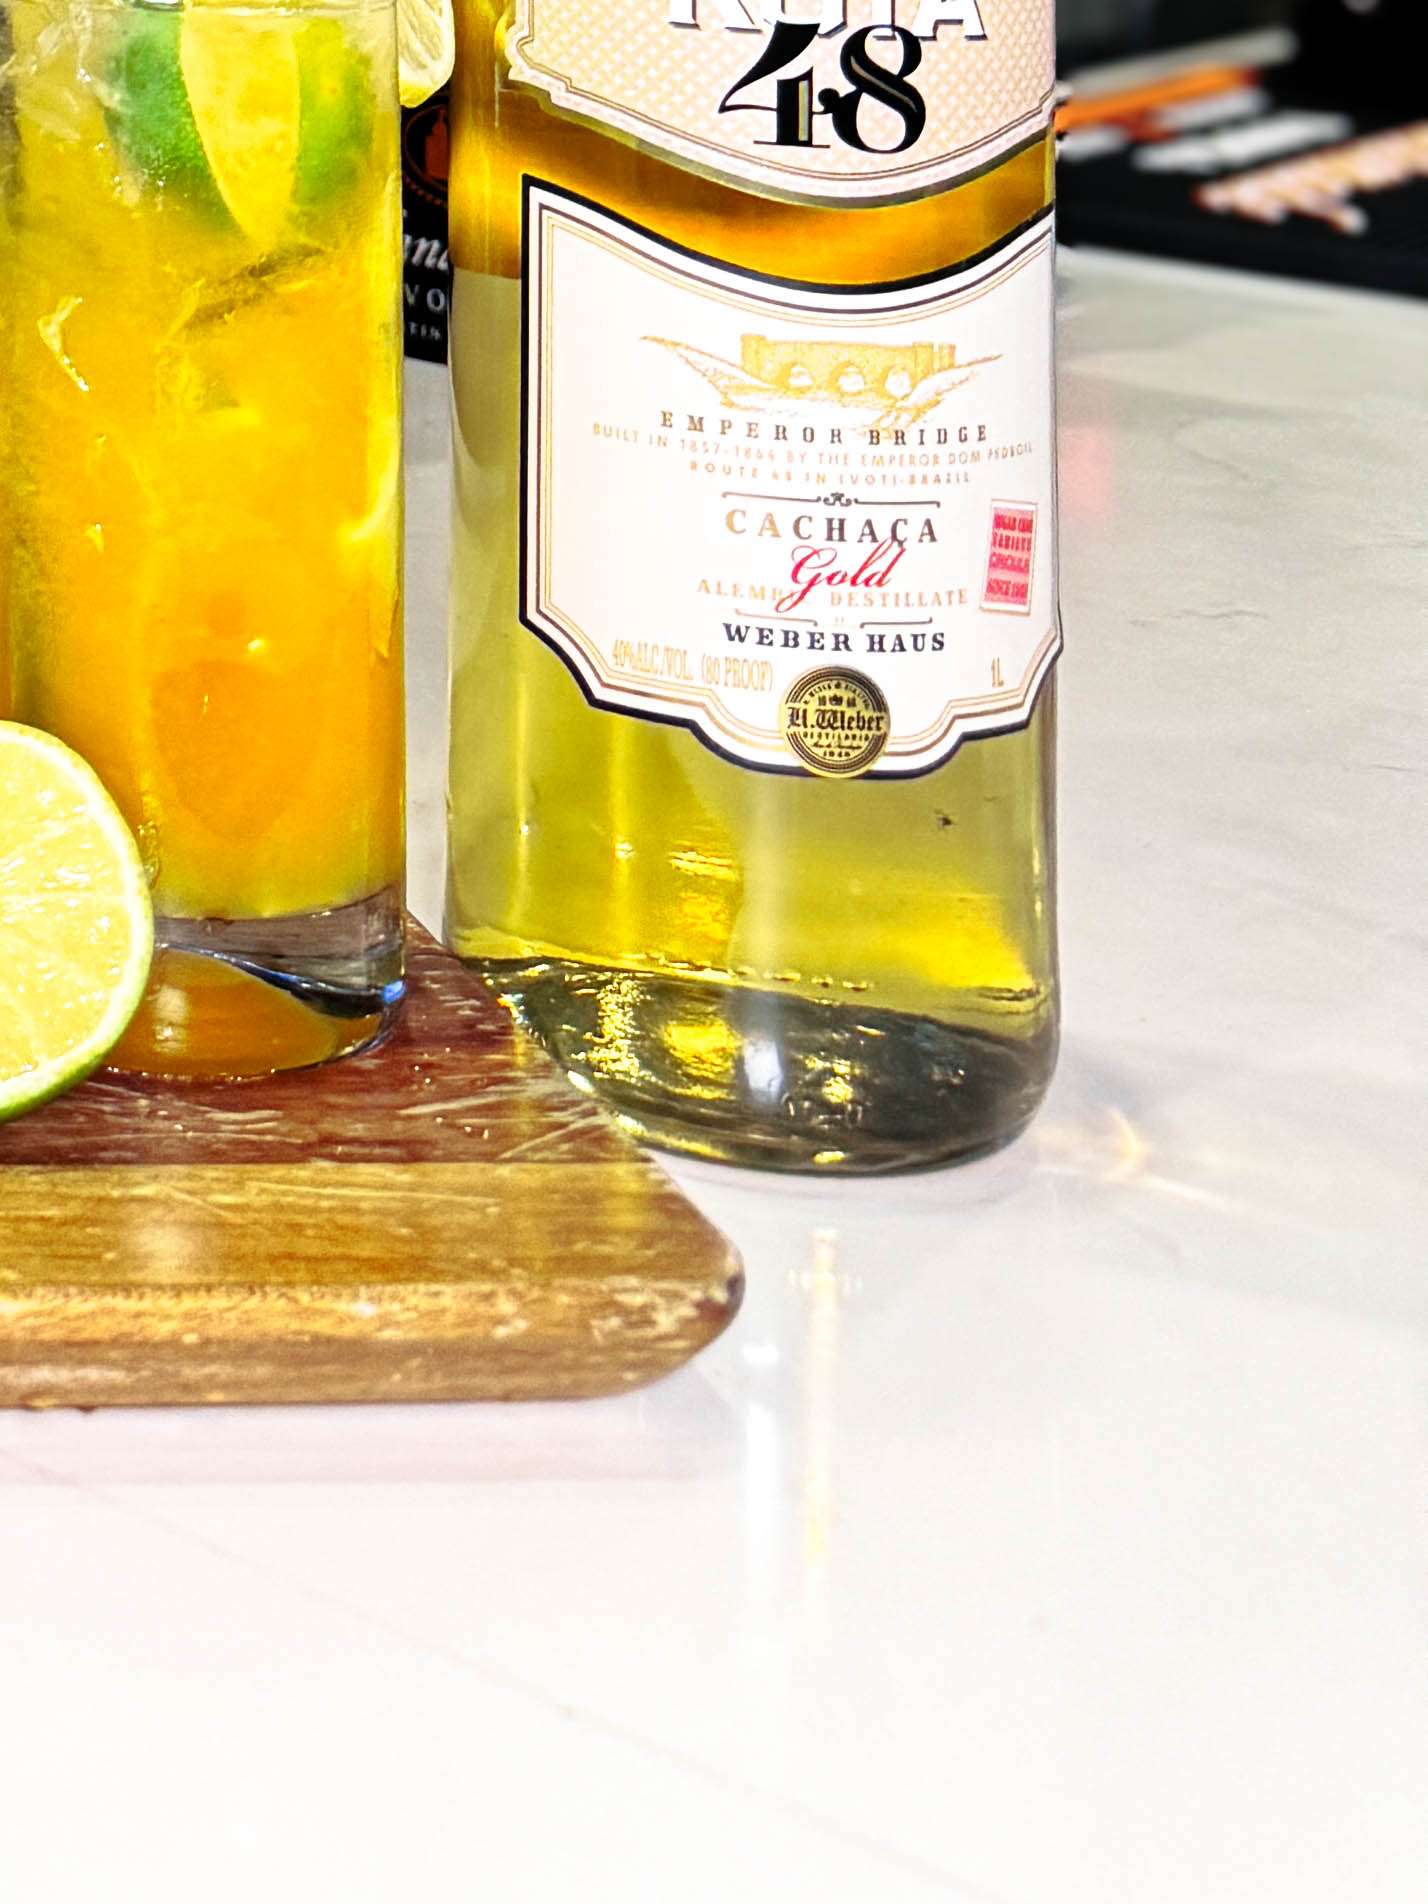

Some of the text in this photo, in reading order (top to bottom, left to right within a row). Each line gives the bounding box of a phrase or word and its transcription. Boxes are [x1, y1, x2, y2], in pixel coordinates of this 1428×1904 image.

[717, 20, 927, 155] 48
[592, 421, 640, 442] BUILT
[818, 451, 849, 466] THE
[861, 453, 940, 467] EMPEROR
[948, 450, 981, 465] DOM
[659, 410, 987, 446] EMPEROR BRIDGE
[689, 459, 759, 479] ROUTE
[724, 508, 939, 549] CACHAÇA
[774, 535, 907, 614] Gold
[830, 588, 969, 608] DESTILLATE
[722, 622, 945, 654] WEBER HAUS
